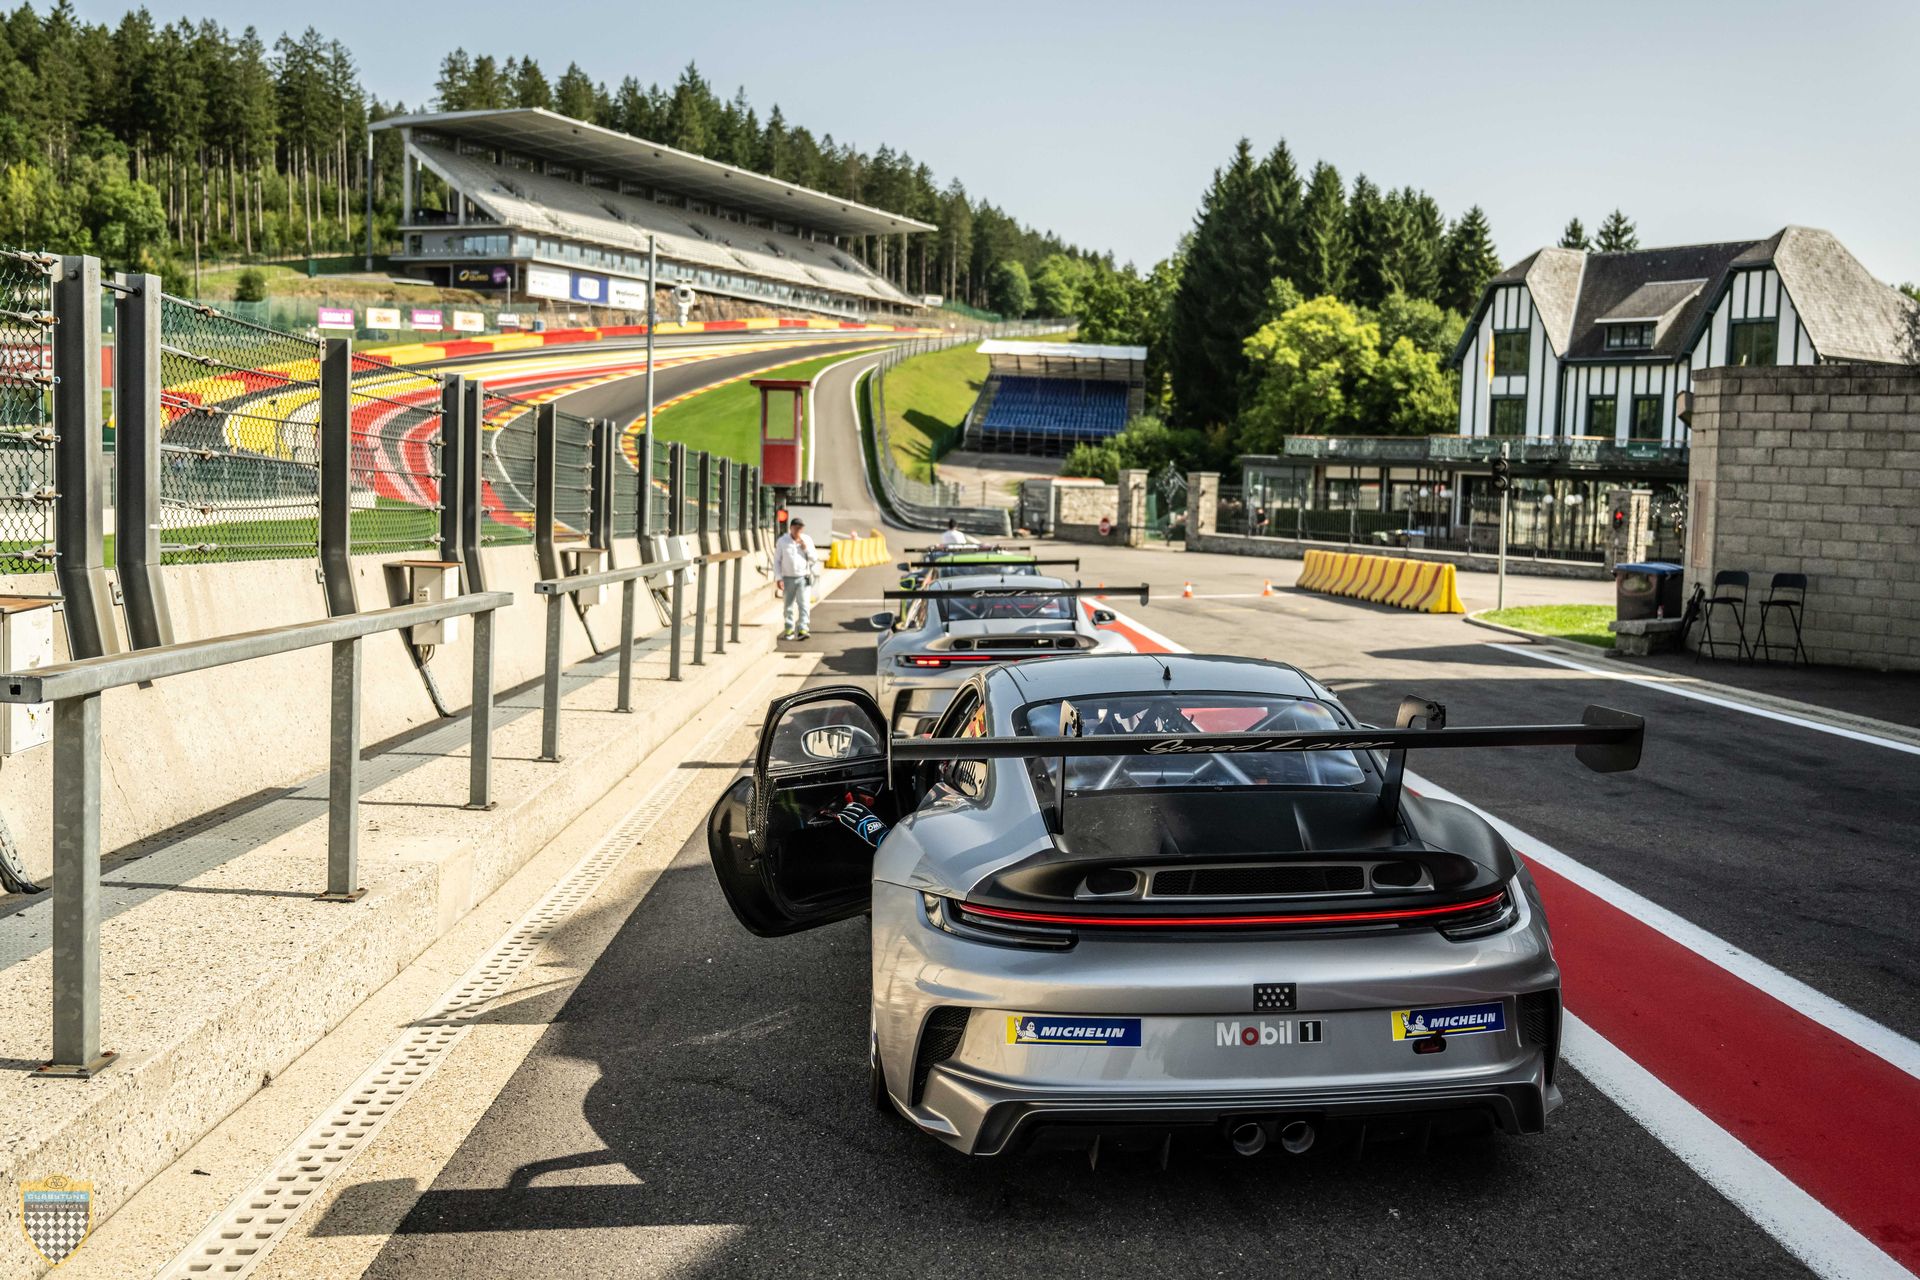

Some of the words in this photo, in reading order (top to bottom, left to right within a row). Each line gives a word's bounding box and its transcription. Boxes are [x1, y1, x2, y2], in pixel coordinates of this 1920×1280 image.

[1143, 739, 1273, 755] Speed
[1266, 738, 1396, 751] Lover
[1430, 1012, 1496, 1028] MICHELIN
[1040, 1026, 1126, 1038] MICHELIN
[1216, 1020, 1293, 1046] Mobil
